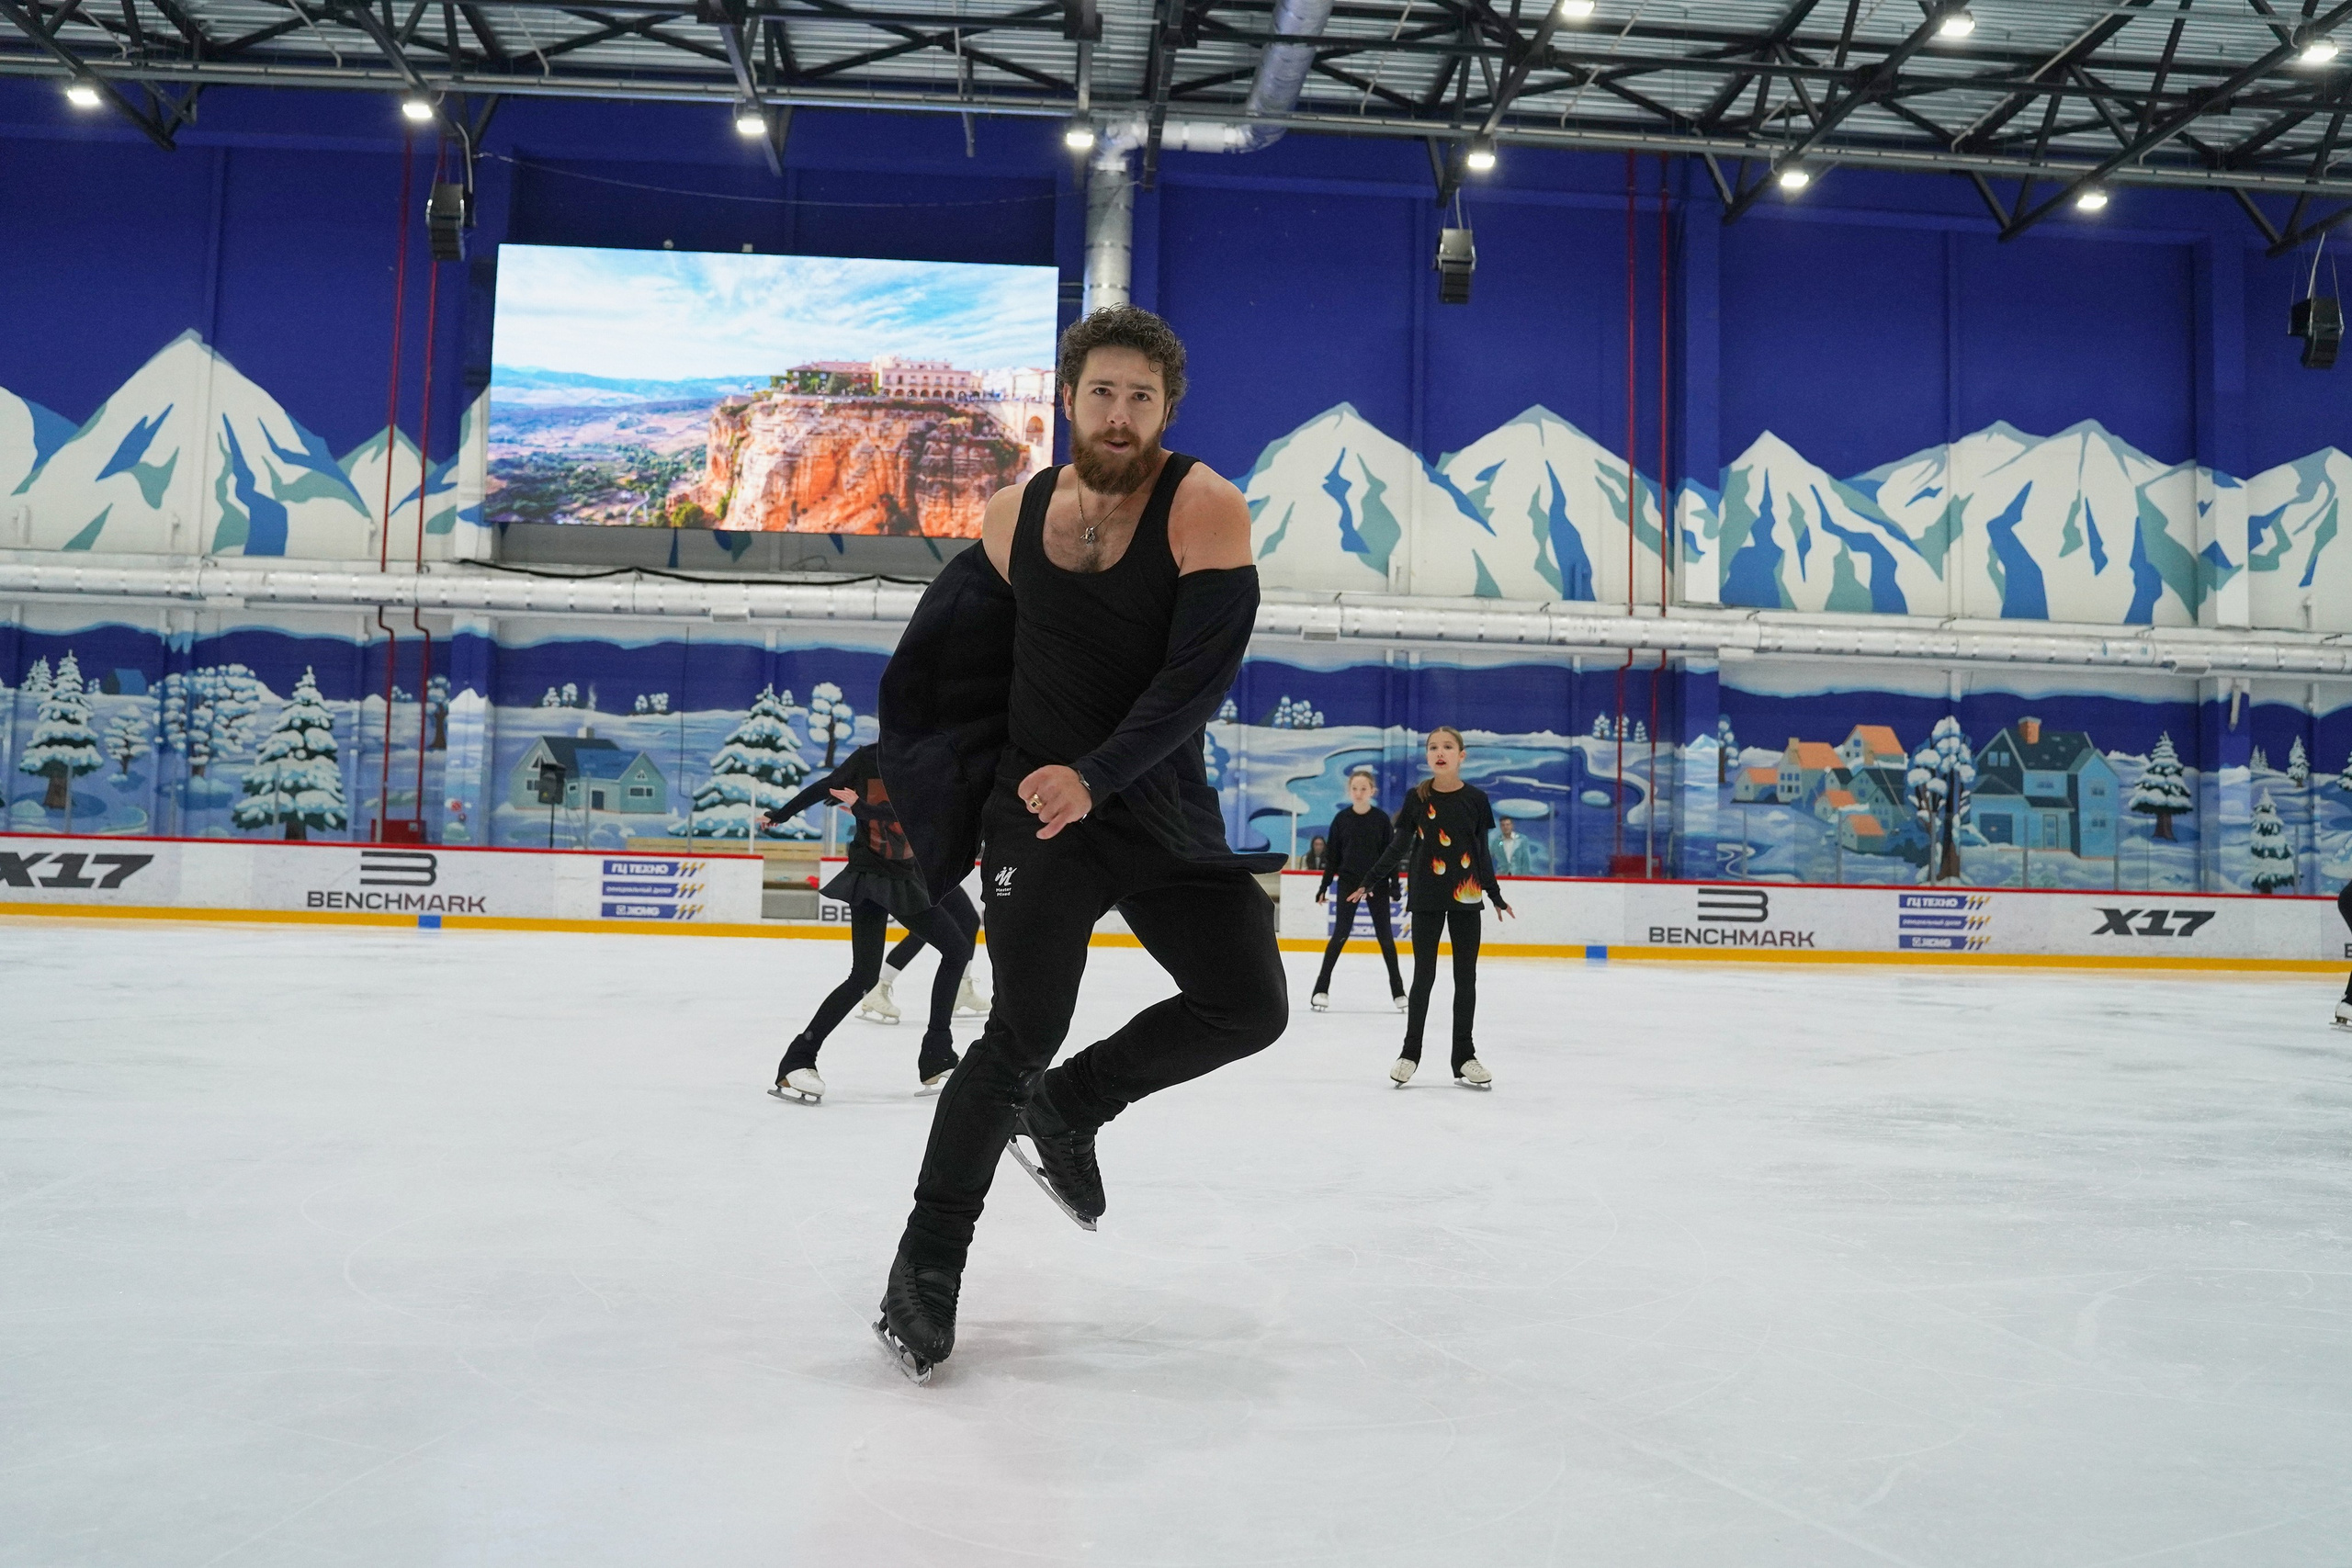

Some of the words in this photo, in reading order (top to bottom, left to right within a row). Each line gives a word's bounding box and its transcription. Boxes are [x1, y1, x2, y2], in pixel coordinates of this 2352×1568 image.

[0, 852, 155, 888] X17
[307, 891, 487, 913] BENCHMARK
[2090, 907, 2216, 937] X17
[1649, 926, 1815, 947] BENCHMARK
